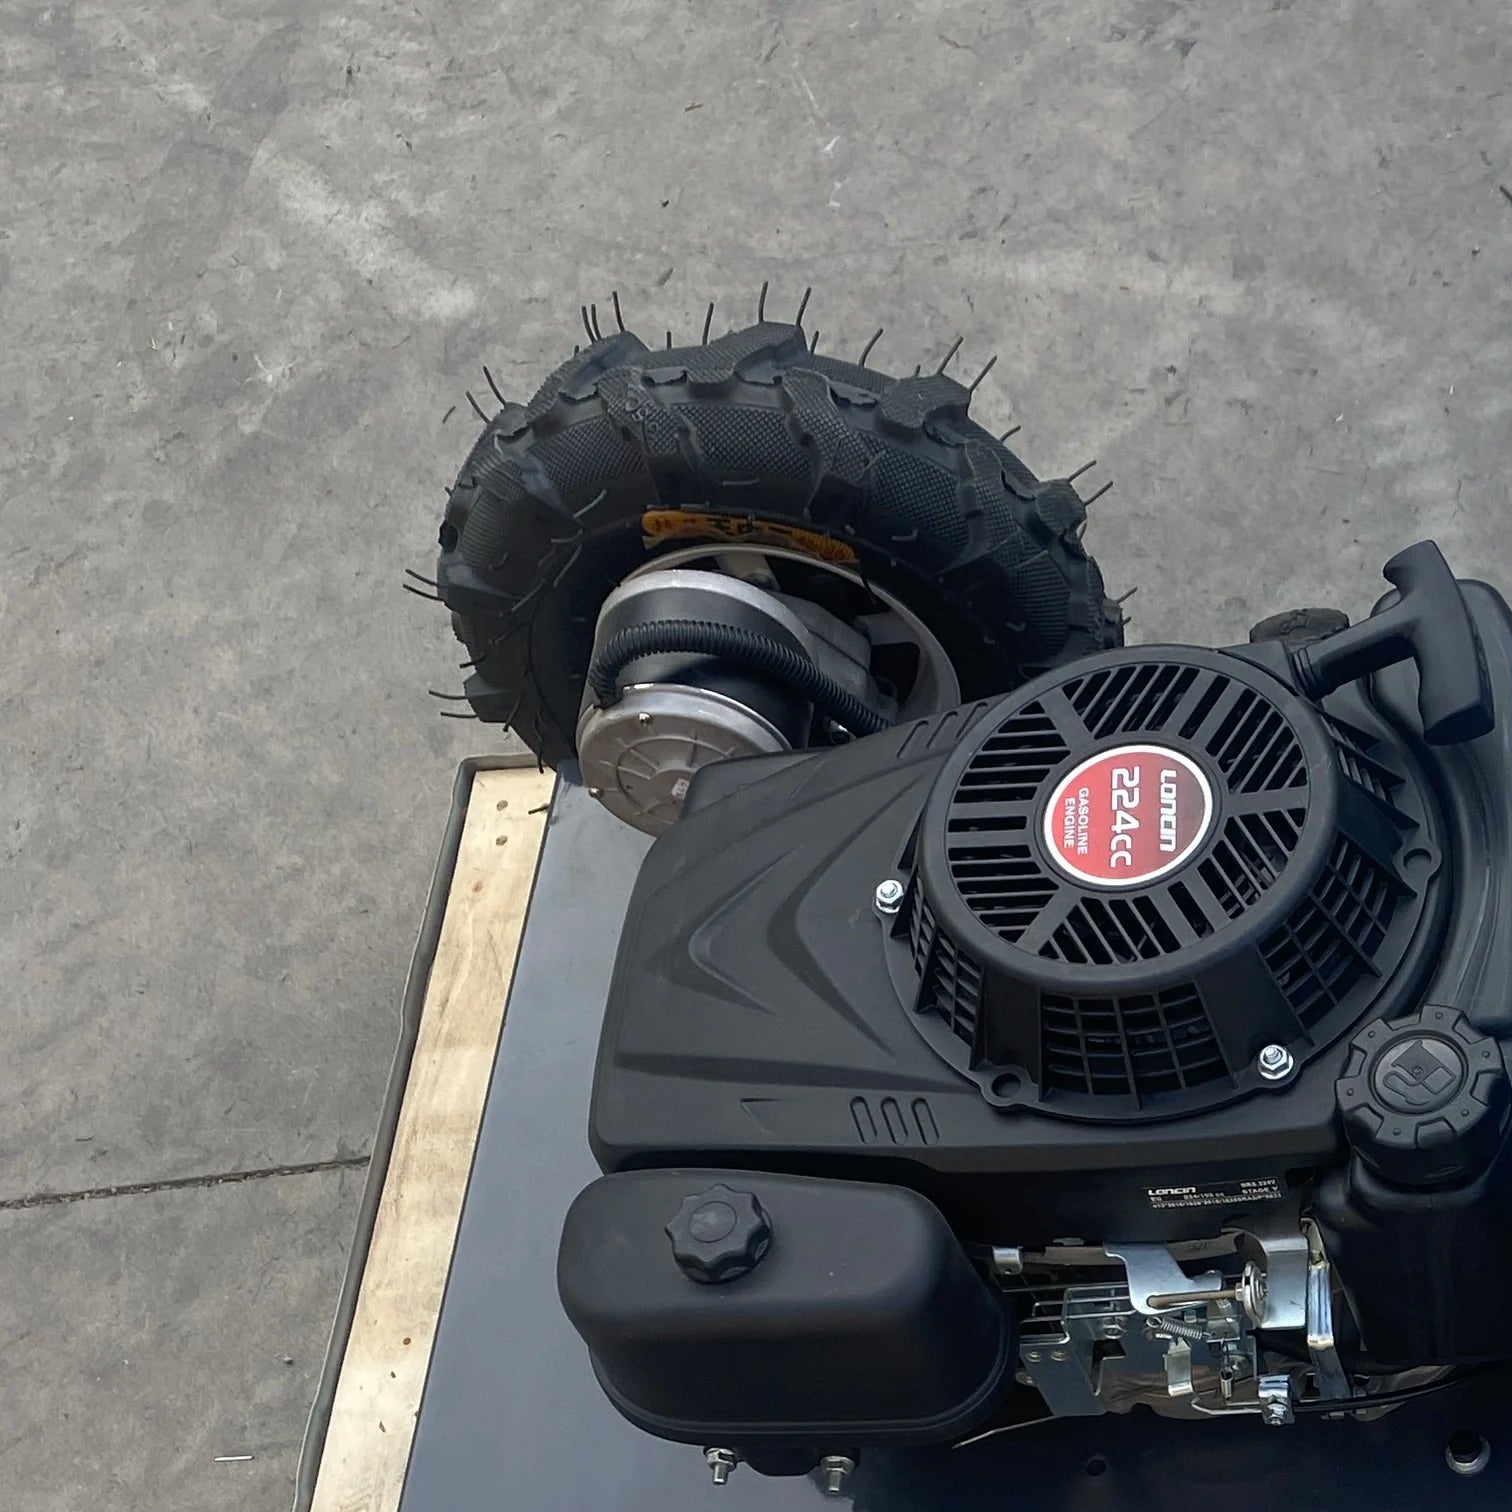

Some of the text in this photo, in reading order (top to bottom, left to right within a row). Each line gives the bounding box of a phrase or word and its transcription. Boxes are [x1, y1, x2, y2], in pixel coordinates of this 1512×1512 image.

[1064, 797, 1076, 849] ENGINE
[1077, 787, 1090, 855] GASOLINE
[1110, 765, 1140, 868] 224cc
[1160, 769, 1177, 852] LONCIN
[1148, 1186, 1196, 1196] LONCIN
